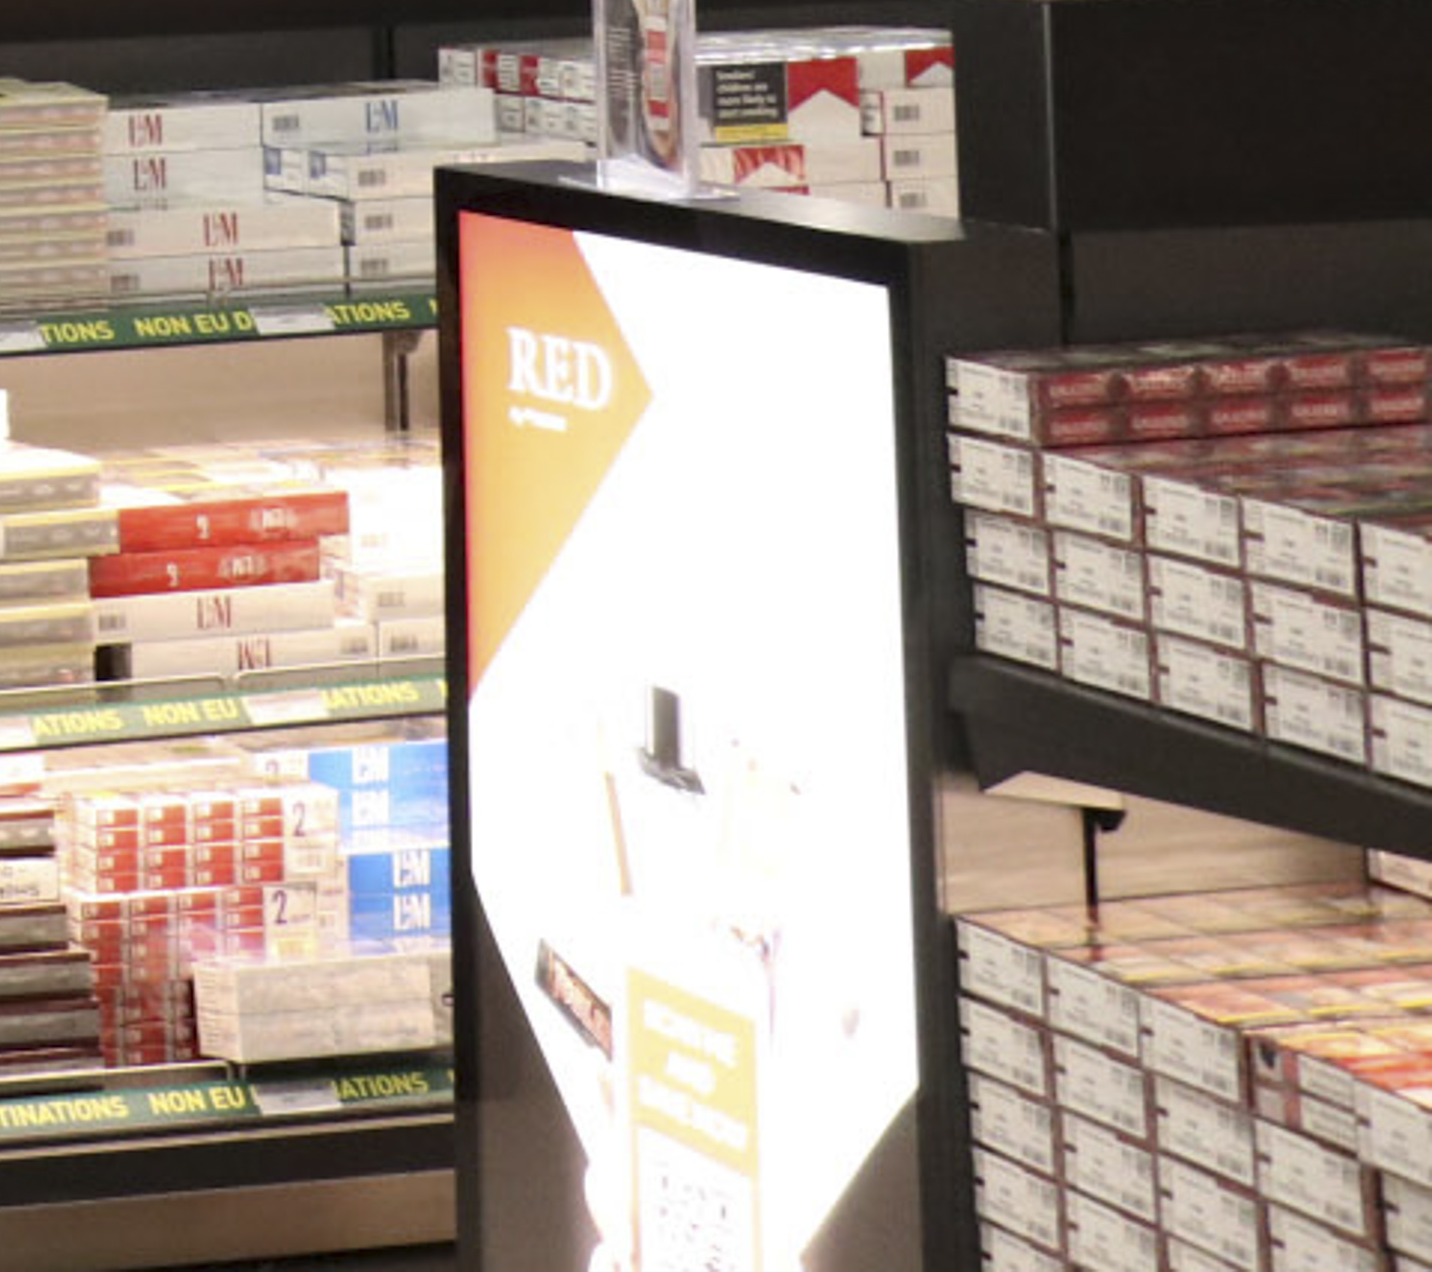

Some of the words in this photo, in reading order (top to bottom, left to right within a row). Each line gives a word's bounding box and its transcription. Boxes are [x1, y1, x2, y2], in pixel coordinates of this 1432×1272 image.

[133, 316, 192, 337] NON
[193, 312, 230, 333] EU
[504, 325, 613, 411] RED
[143, 703, 201, 727] NON
[202, 698, 241, 720] EU
[272, 889, 288, 925] 2
[146, 1091, 207, 1115] NON
[208, 1086, 245, 1109] EU
